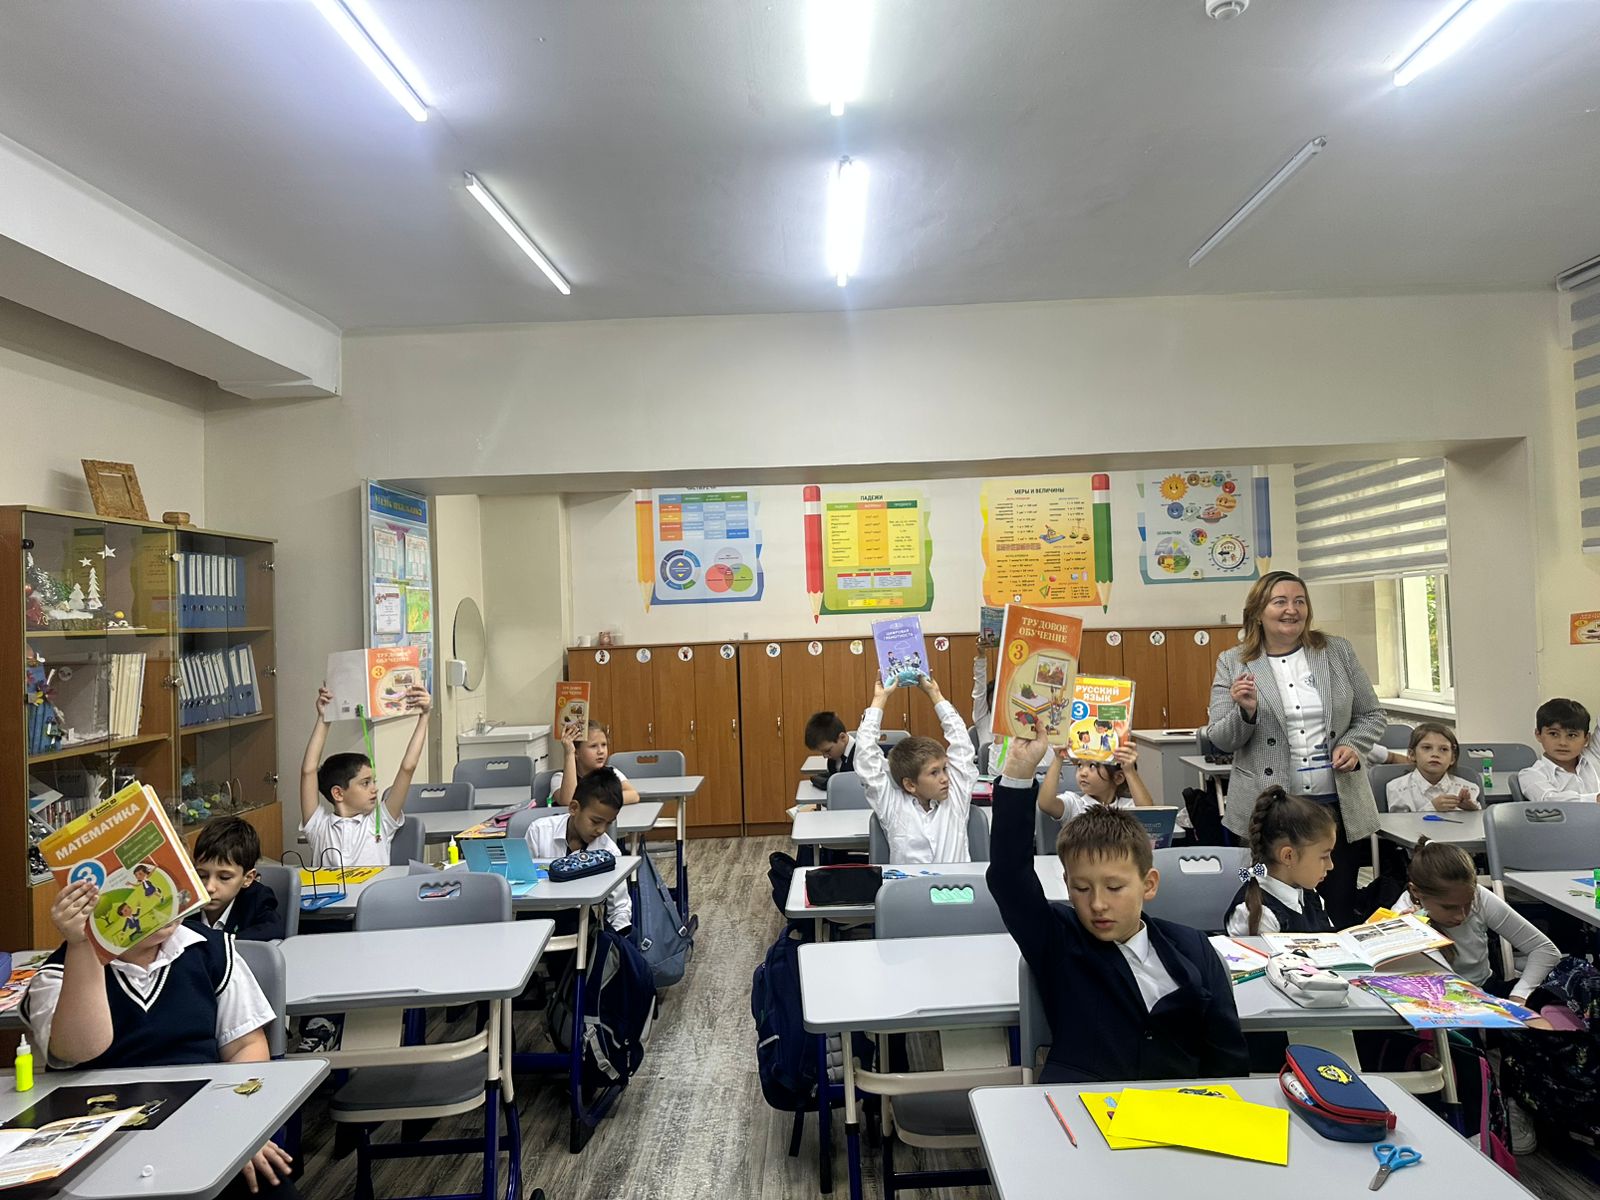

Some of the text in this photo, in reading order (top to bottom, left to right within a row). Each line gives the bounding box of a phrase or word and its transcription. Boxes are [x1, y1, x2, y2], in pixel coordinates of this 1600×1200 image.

[1021, 616, 1068, 633] ТРУДОВОЕ
[1019, 626, 1068, 644] ОБУЧЕНИЕ
[1013, 643, 1024, 660] 3
[375, 667, 383, 676] 3
[1075, 685, 1120, 696] РУССКИЙ
[1083, 693, 1111, 702] ЯЗЫК
[1073, 703, 1085, 716] 3
[56, 803, 140, 861] МАТЕМАТИКА
